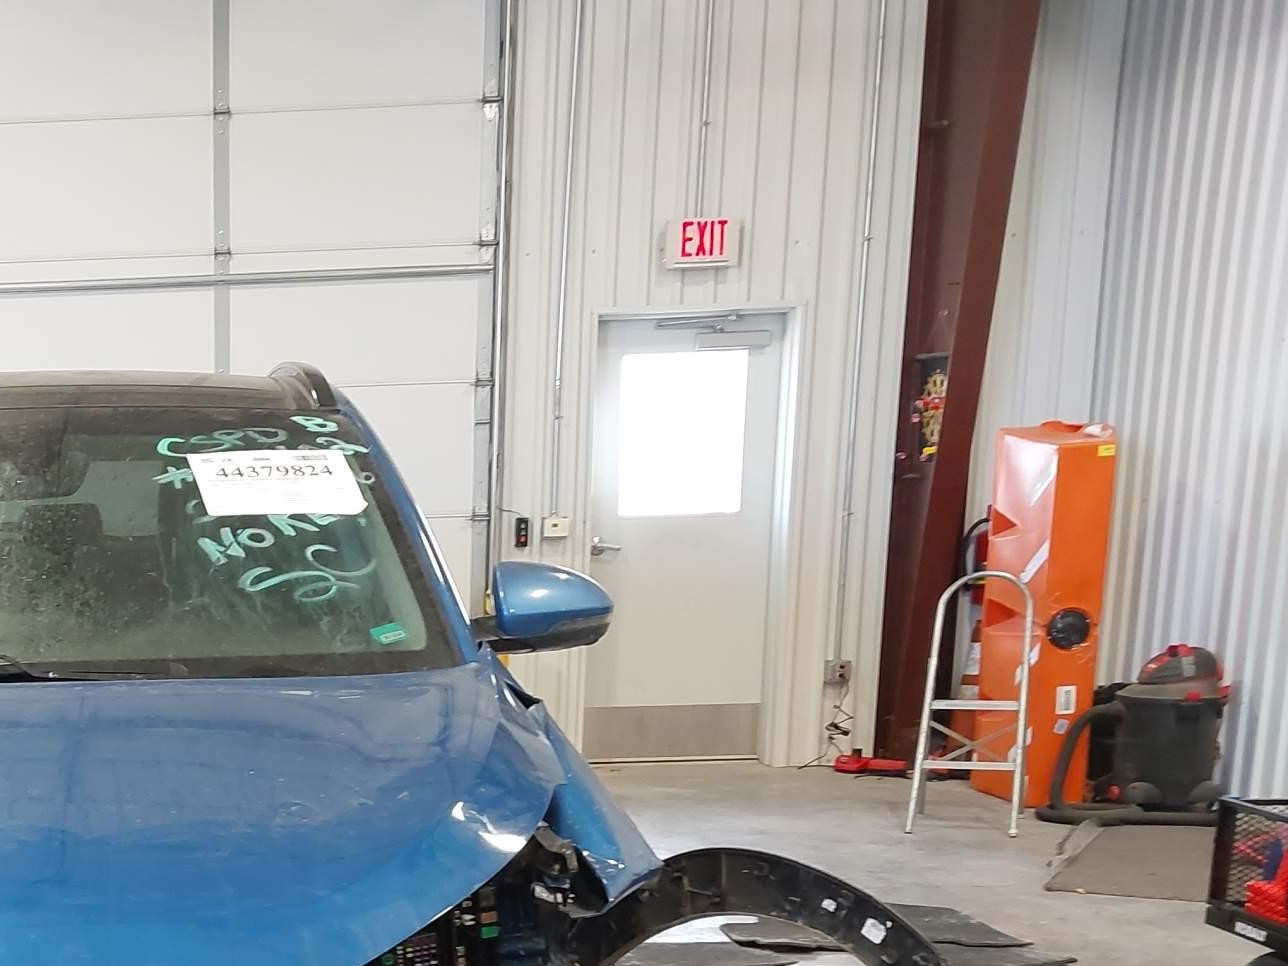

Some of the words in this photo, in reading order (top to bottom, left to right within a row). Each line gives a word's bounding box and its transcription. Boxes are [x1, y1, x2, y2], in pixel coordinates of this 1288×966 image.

[680, 219, 729, 258] EXIT
[215, 464, 334, 479] 44379824
[196, 526, 276, 566] NO
